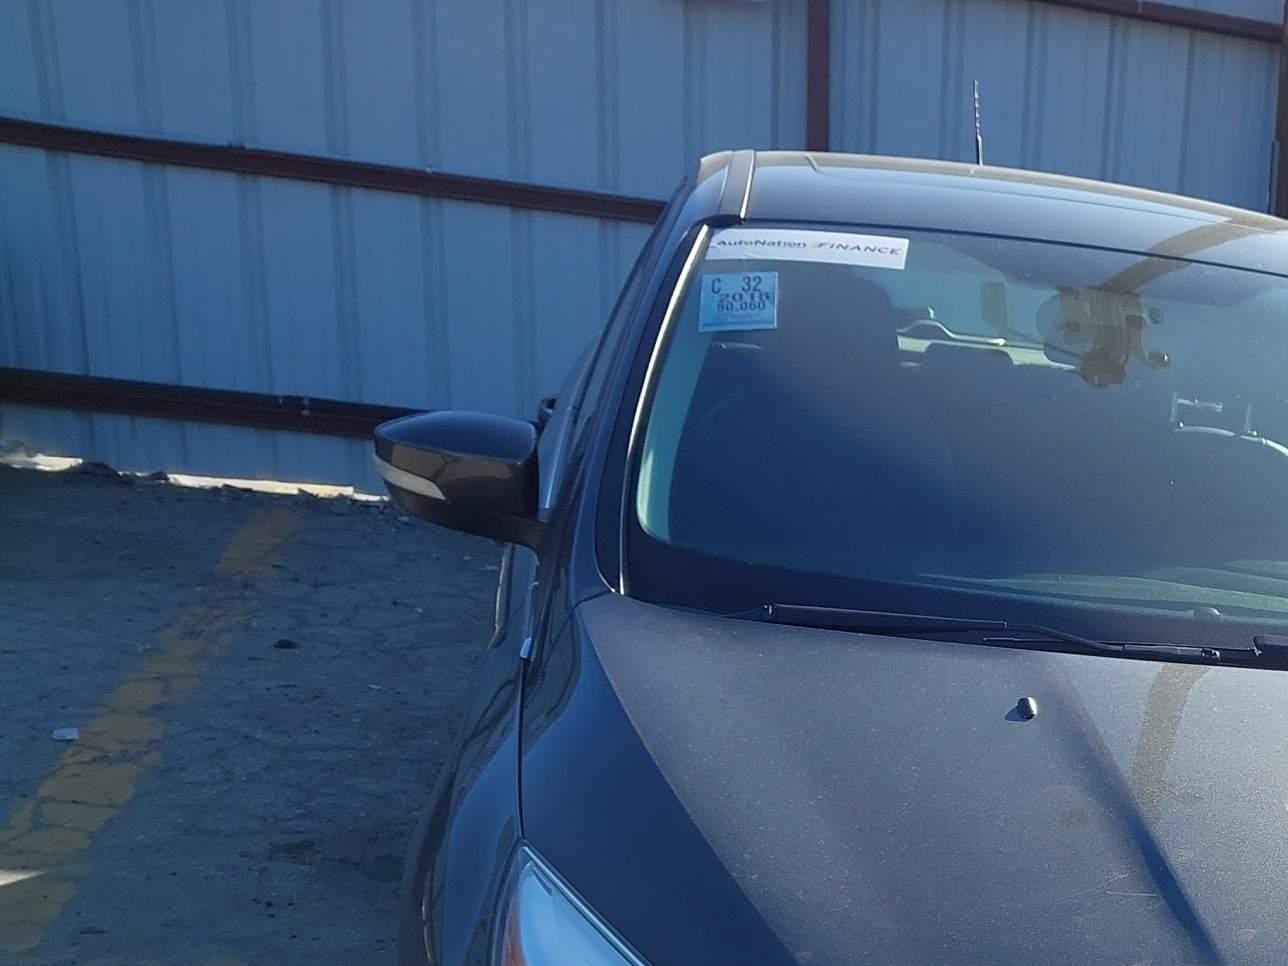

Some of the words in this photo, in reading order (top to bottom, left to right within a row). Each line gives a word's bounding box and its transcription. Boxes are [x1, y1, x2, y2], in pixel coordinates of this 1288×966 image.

[717, 238, 807, 249] AutoNation
[815, 241, 903, 256] FINANCE
[711, 277, 722, 295] C
[742, 275, 762, 293] 32
